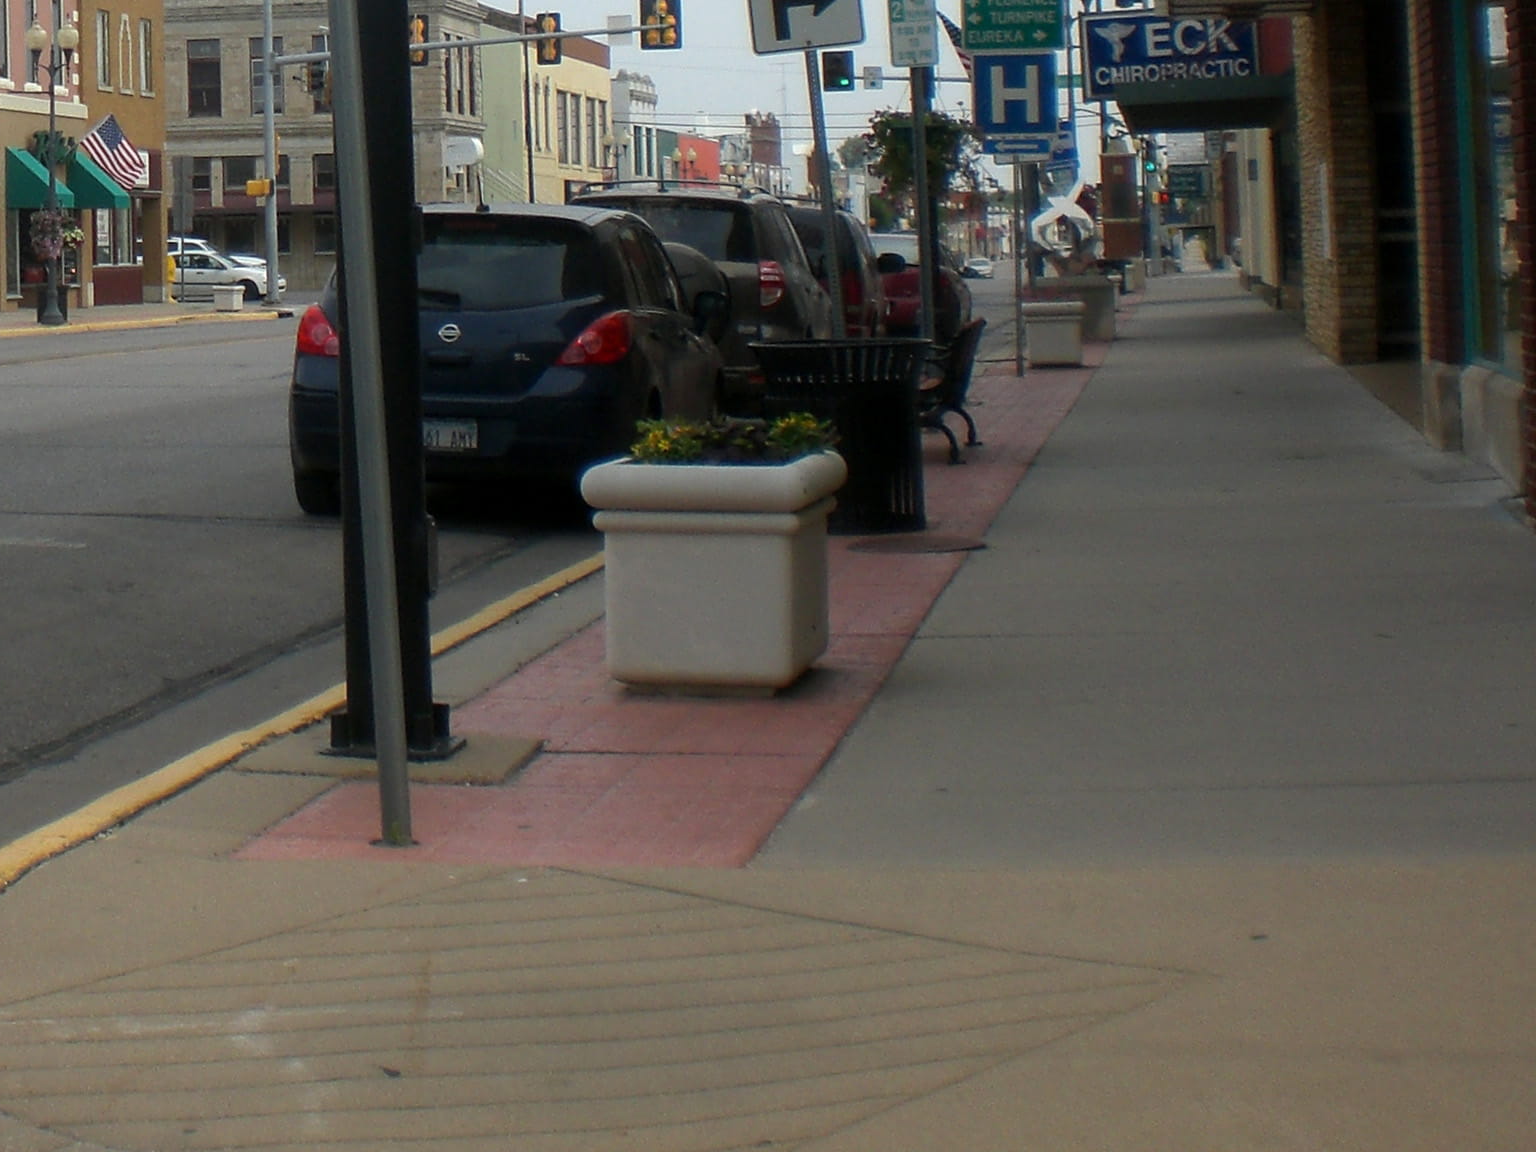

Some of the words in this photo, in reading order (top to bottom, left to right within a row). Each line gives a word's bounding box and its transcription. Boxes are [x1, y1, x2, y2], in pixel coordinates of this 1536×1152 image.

[891, 1, 902, 18] 2
[989, 10, 1057, 25] TURNPIKE
[968, 29, 1025, 44] EUREKA
[1144, 18, 1240, 58] ECK
[1095, 58, 1251, 86] CHIROPRACTIC
[990, 64, 1040, 124] H
